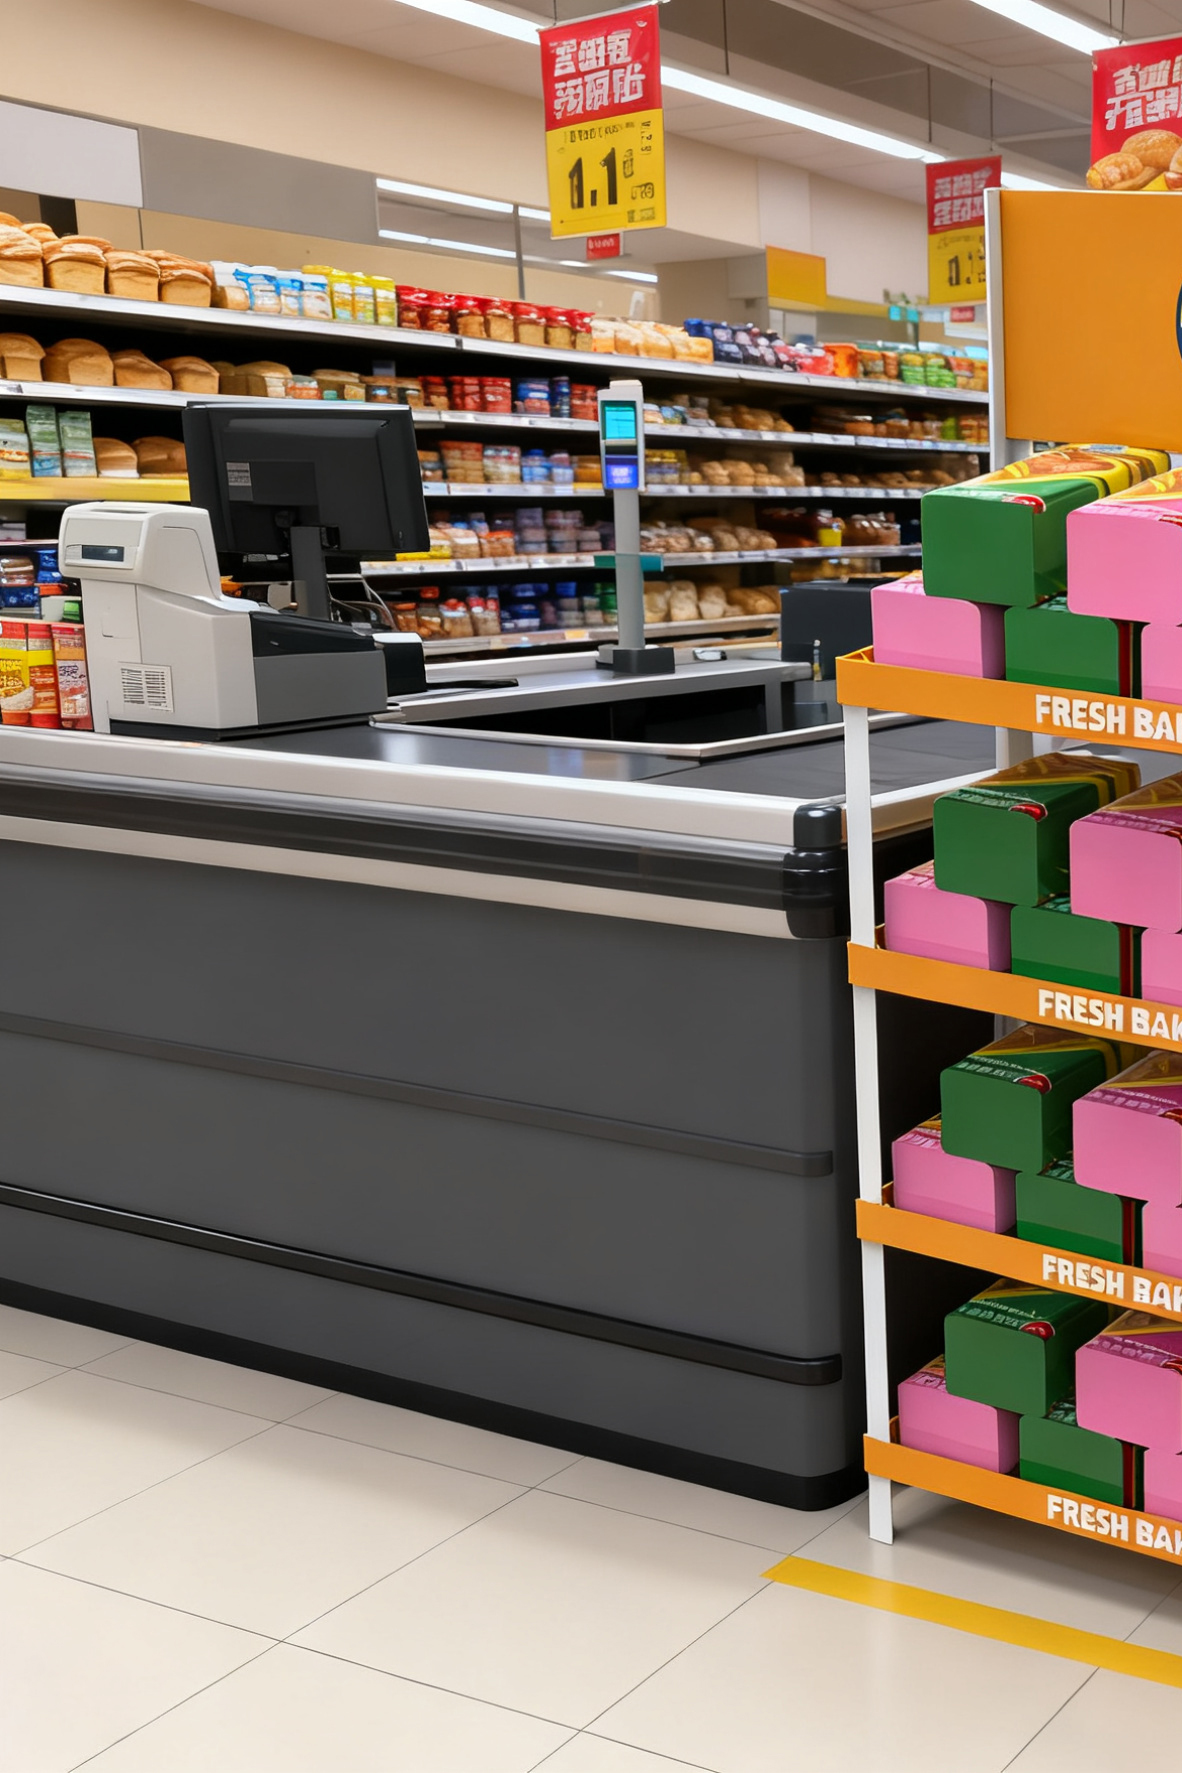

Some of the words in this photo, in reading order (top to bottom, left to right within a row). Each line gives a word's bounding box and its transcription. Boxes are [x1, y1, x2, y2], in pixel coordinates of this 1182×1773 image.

[568, 147, 619, 210] 1.1
[1035, 694, 1126, 735] FRESH
[1038, 989, 1124, 1032] FRESH
[1042, 1253, 1125, 1299] FRESH
[1047, 1493, 1129, 1542] FRESH
